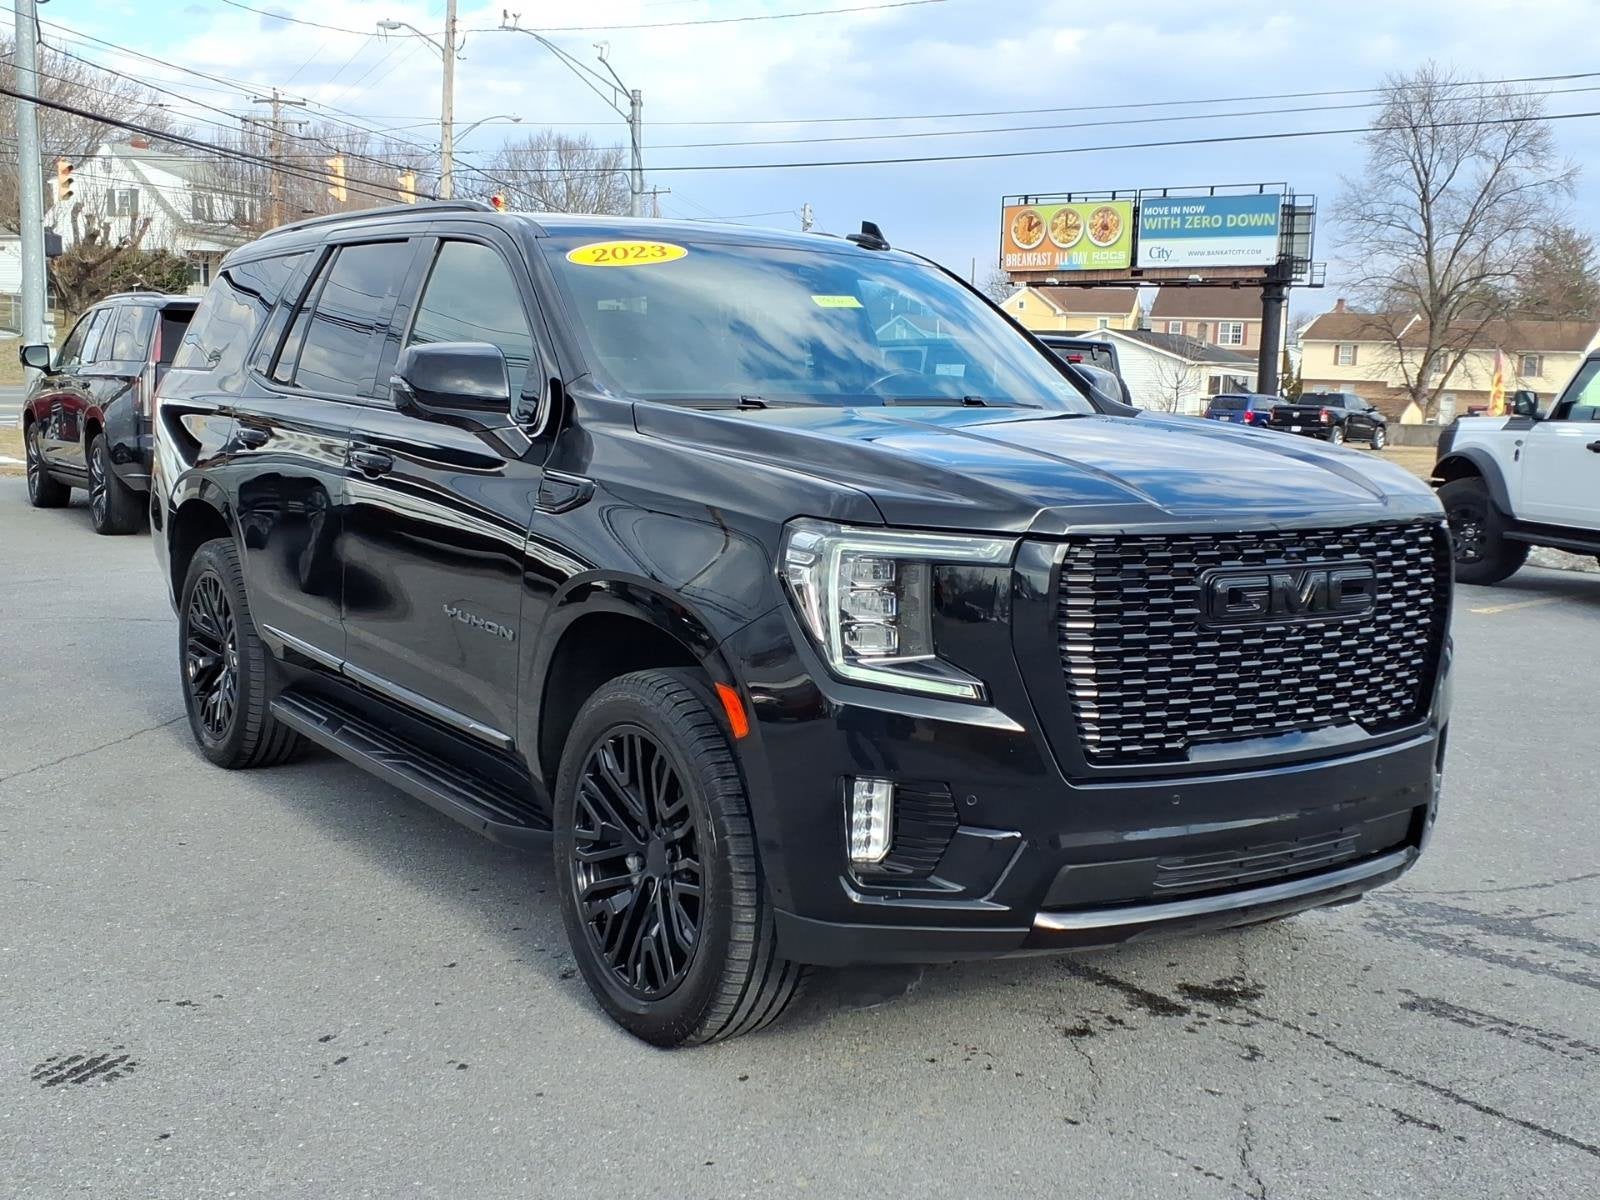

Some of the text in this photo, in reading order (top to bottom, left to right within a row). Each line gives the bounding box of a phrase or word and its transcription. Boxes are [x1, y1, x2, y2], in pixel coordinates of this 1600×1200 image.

[1144, 205, 1205, 215] MOVE IN NOW
[1144, 213, 1276, 230] WITH ZERO DOWN
[592, 244, 668, 263] 2023
[1006, 252, 1052, 267] BREAKFAST
[1055, 251, 1070, 266] ALL
[1149, 246, 1173, 261] City
[1187, 249, 1262, 257] WWW.BANKATCITY.COM
[1217, 568, 1373, 617] GMC
[443, 604, 514, 640] YUKON
